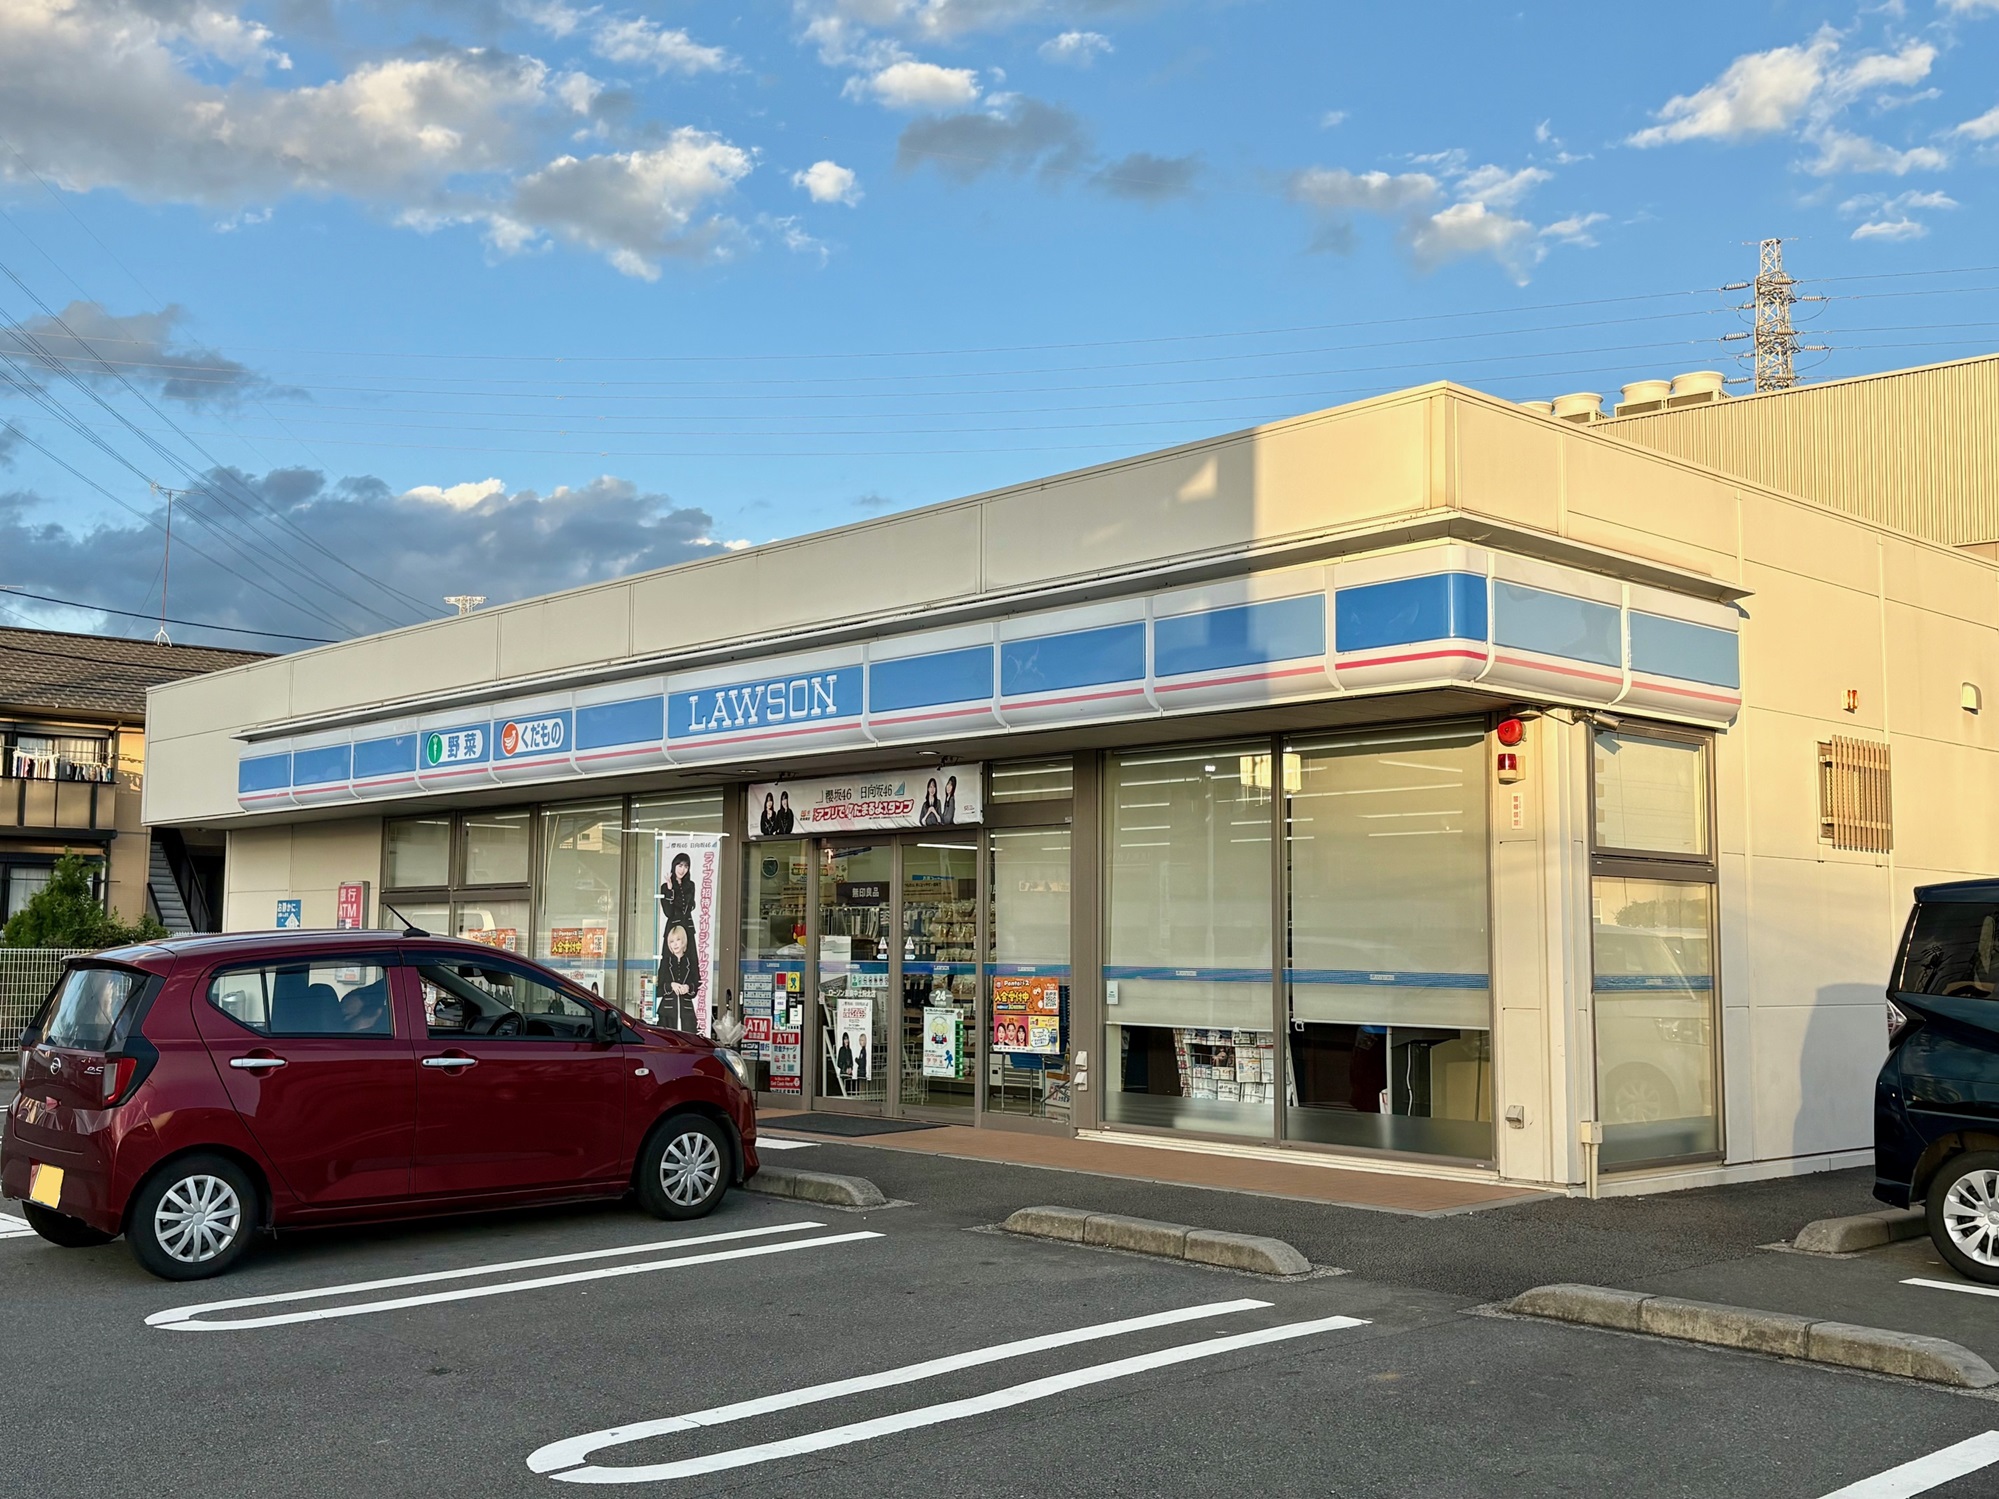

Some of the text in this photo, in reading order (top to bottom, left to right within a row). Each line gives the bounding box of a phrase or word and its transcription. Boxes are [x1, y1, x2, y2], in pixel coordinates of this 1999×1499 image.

[689, 674, 838, 732] LAWSON
[520, 721, 562, 749] くだもの
[447, 732, 477, 759] 野菜
[860, 784, 893, 799] 日向坂46
[852, 886, 880, 898] 無印良品
[338, 903, 357, 918] ATM
[935, 990, 947, 1001] 24
[747, 1019, 767, 1033] ATM
[776, 1033, 795, 1044] ATM
